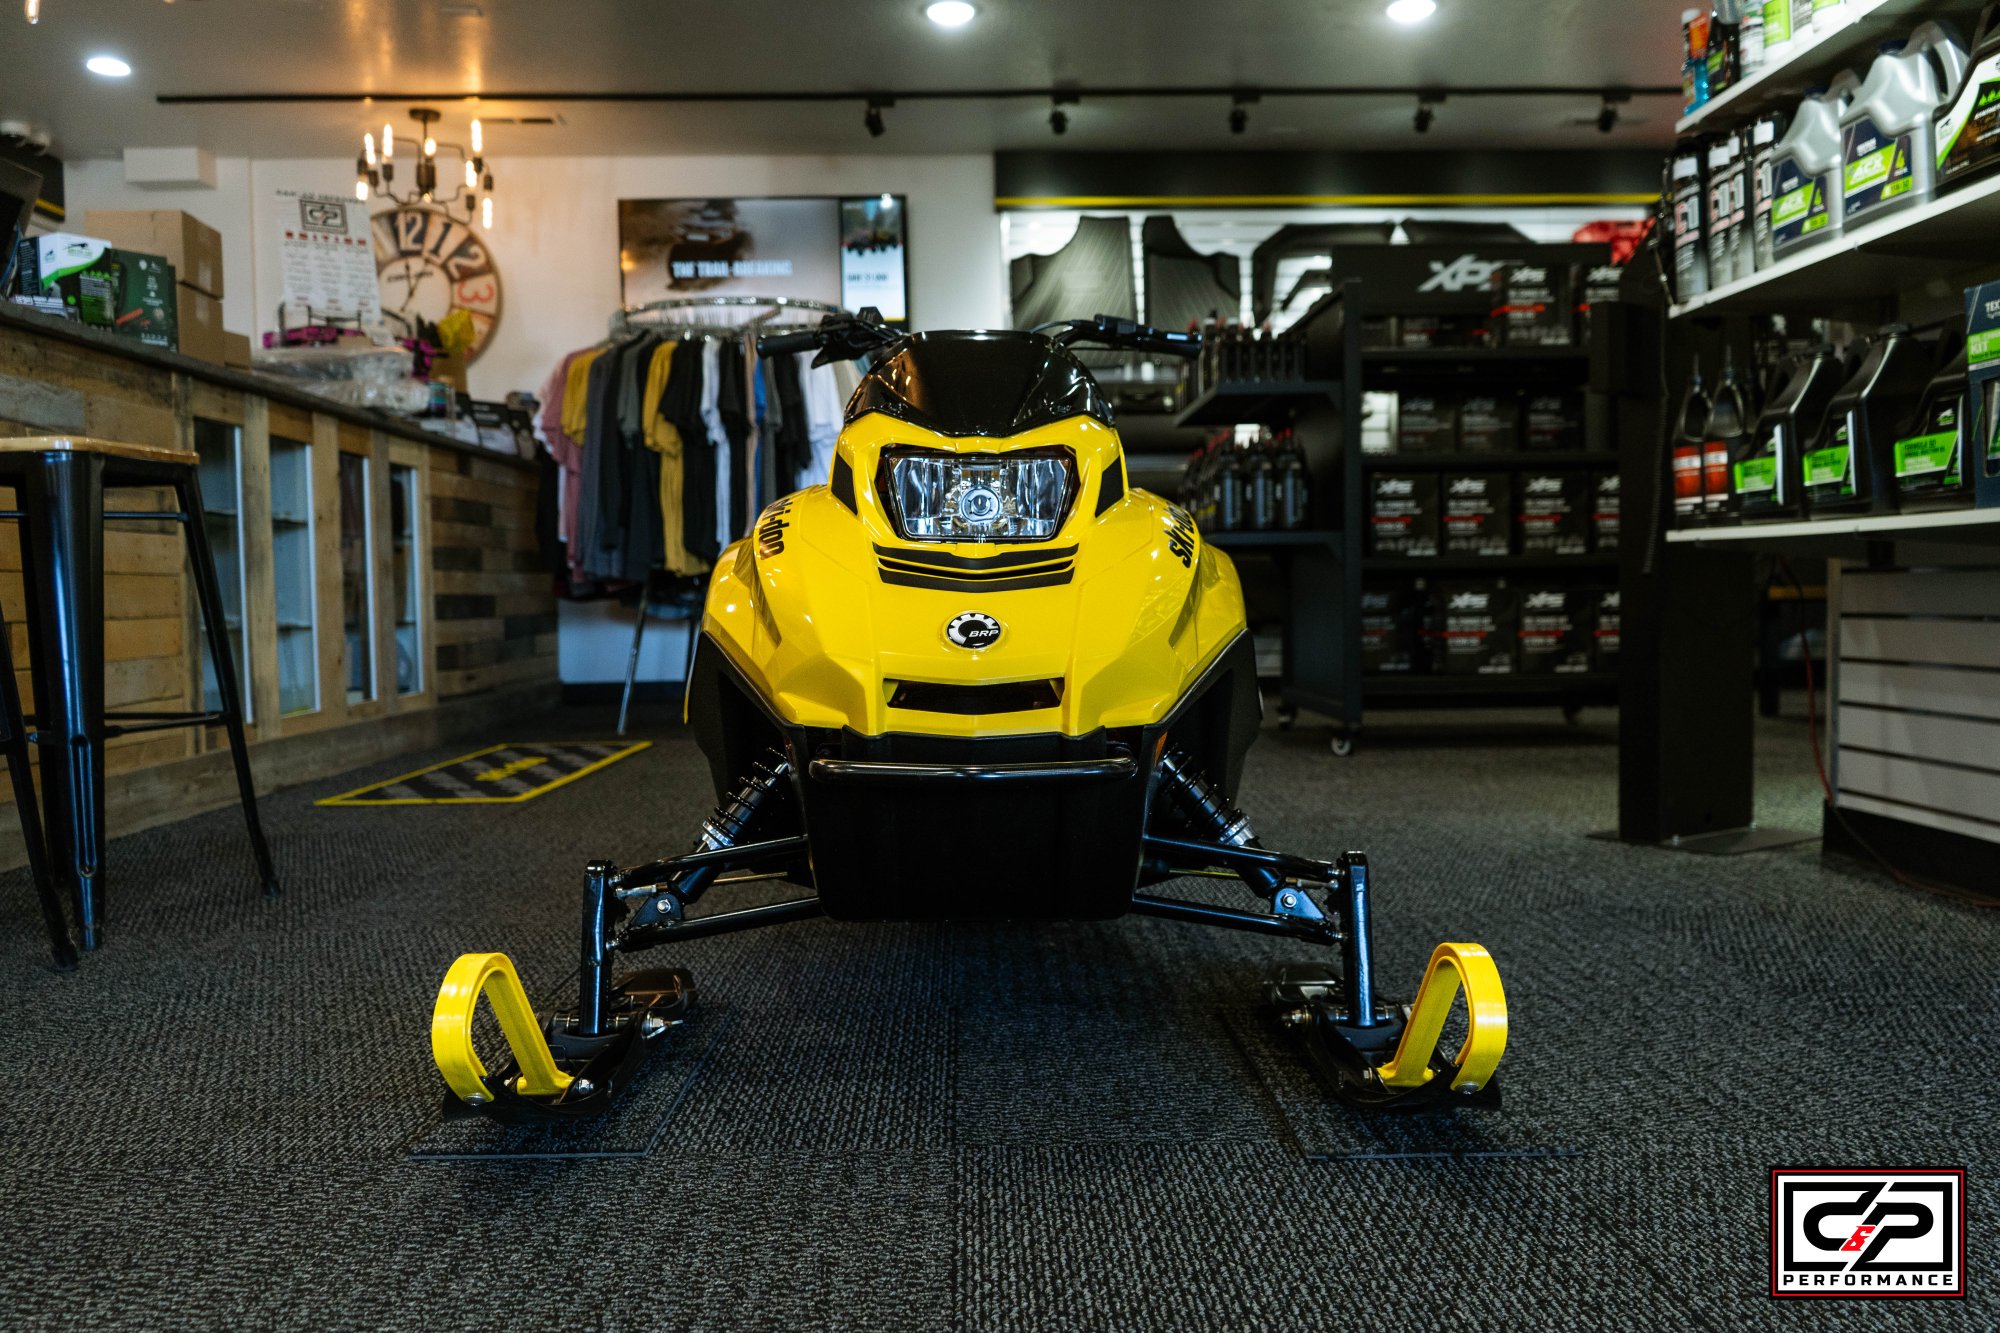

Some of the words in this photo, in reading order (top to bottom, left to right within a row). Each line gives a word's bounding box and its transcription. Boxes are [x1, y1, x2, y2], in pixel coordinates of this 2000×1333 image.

[447, 243, 487, 280] 2
[457, 281, 496, 304] 3
[759, 499, 793, 560] ki-doo
[968, 629, 999, 638] BRP
